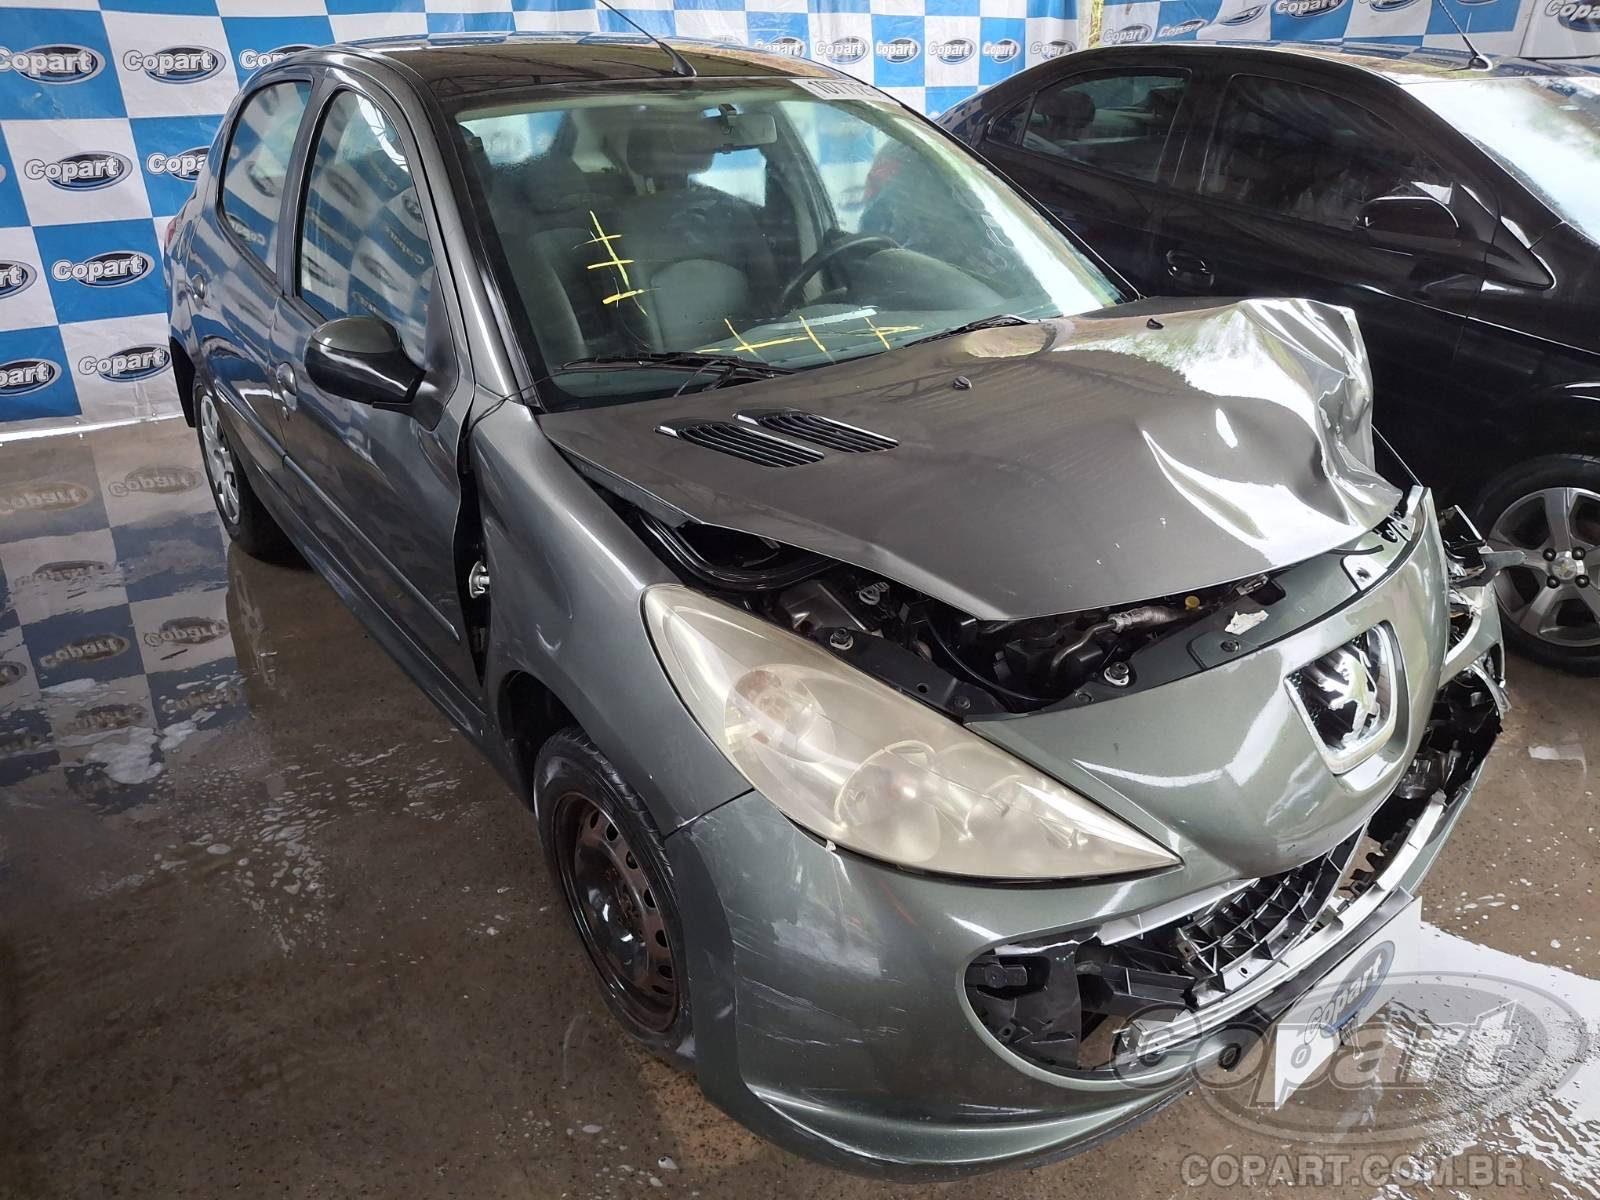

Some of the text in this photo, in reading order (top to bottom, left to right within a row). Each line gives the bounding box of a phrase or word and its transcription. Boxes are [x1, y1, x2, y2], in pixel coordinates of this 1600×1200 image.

[1546, 0, 1600, 21] Copa
[1103, 27, 1146, 43] Copart
[815, 41, 863, 56] Copart
[876, 39, 915, 57] Copart
[928, 40, 970, 57] Copart
[983, 40, 1017, 57] Copart
[123, 46, 213, 75] Copart
[25, 155, 118, 182] Copart
[147, 153, 206, 177] Copa
[52, 254, 144, 282] Copart
[78, 348, 166, 376] Copart
